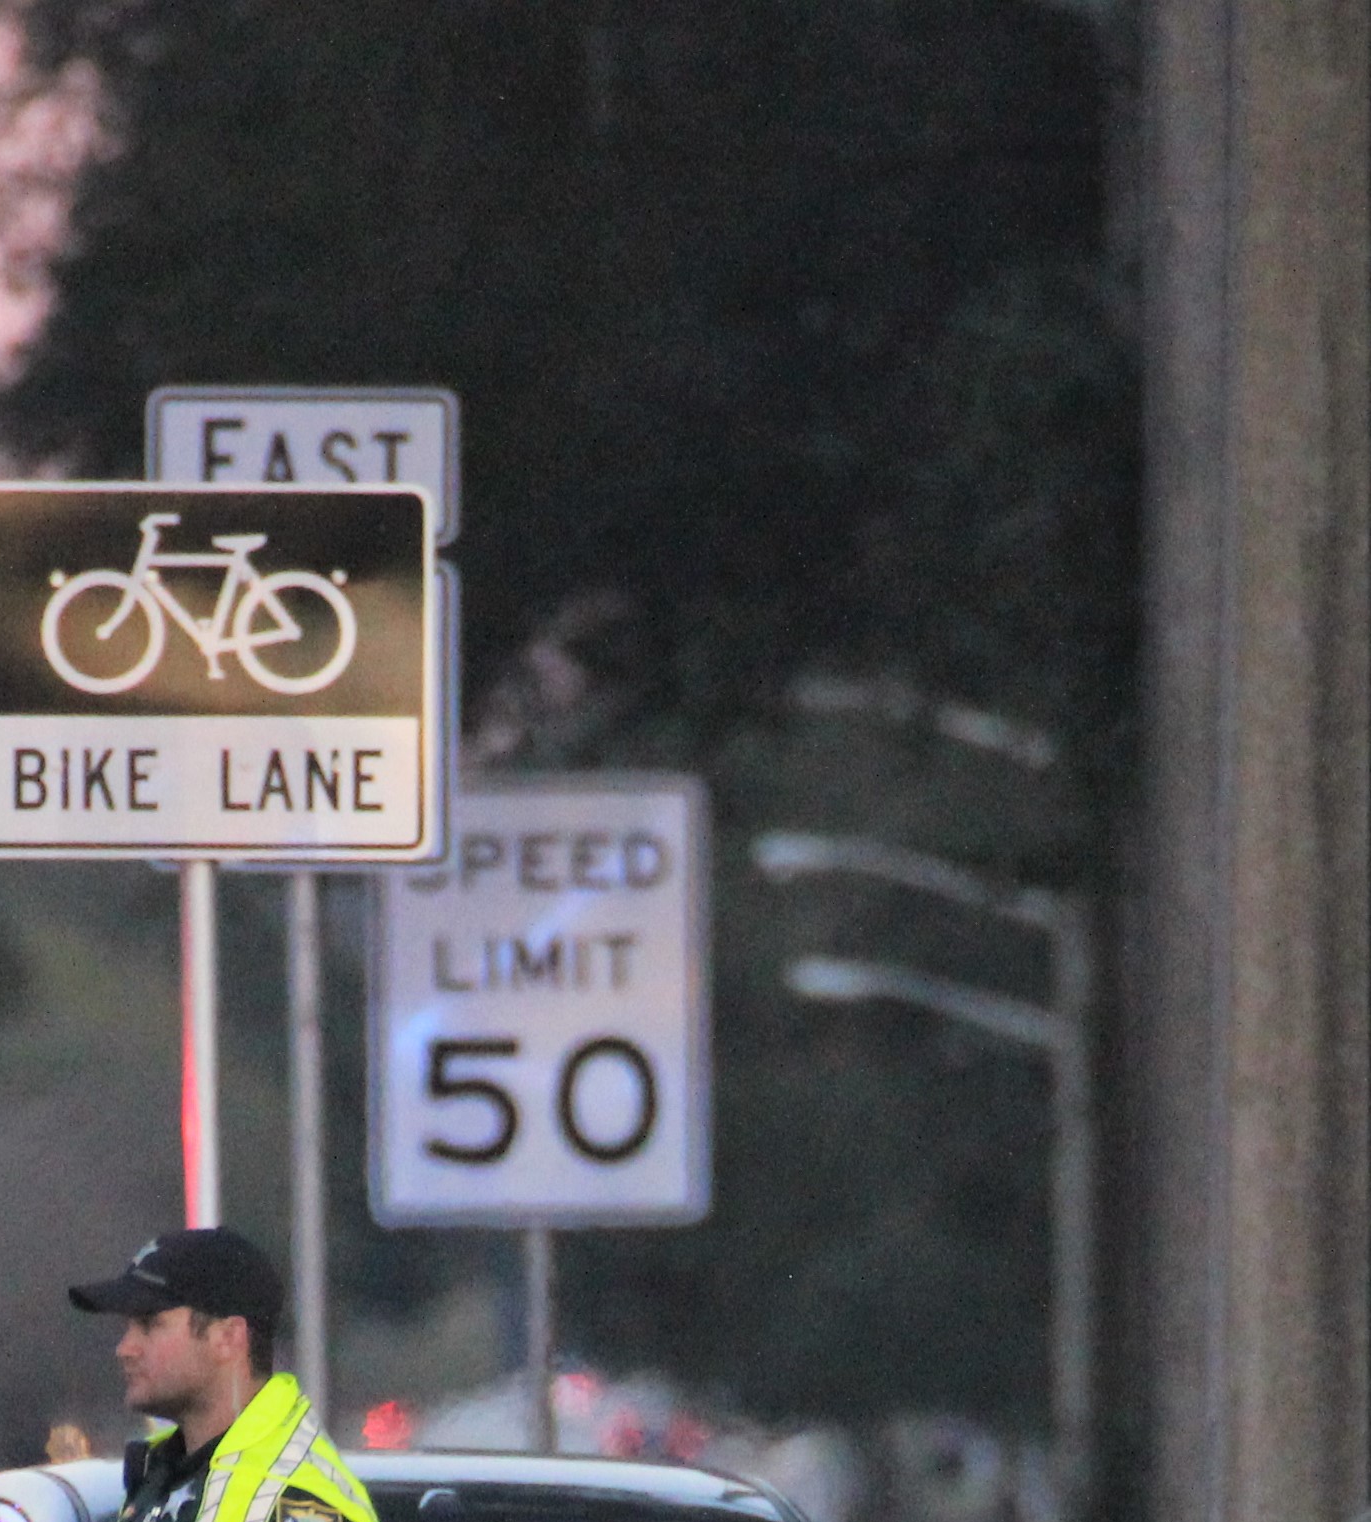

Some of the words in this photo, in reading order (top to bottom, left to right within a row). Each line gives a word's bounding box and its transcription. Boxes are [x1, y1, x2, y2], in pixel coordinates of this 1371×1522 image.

[12, 747, 159, 813] BIKE
[220, 748, 384, 813] LANE
[407, 829, 671, 893] PEED
[432, 931, 635, 991] LIMIT
[425, 1036, 658, 1165] 50
